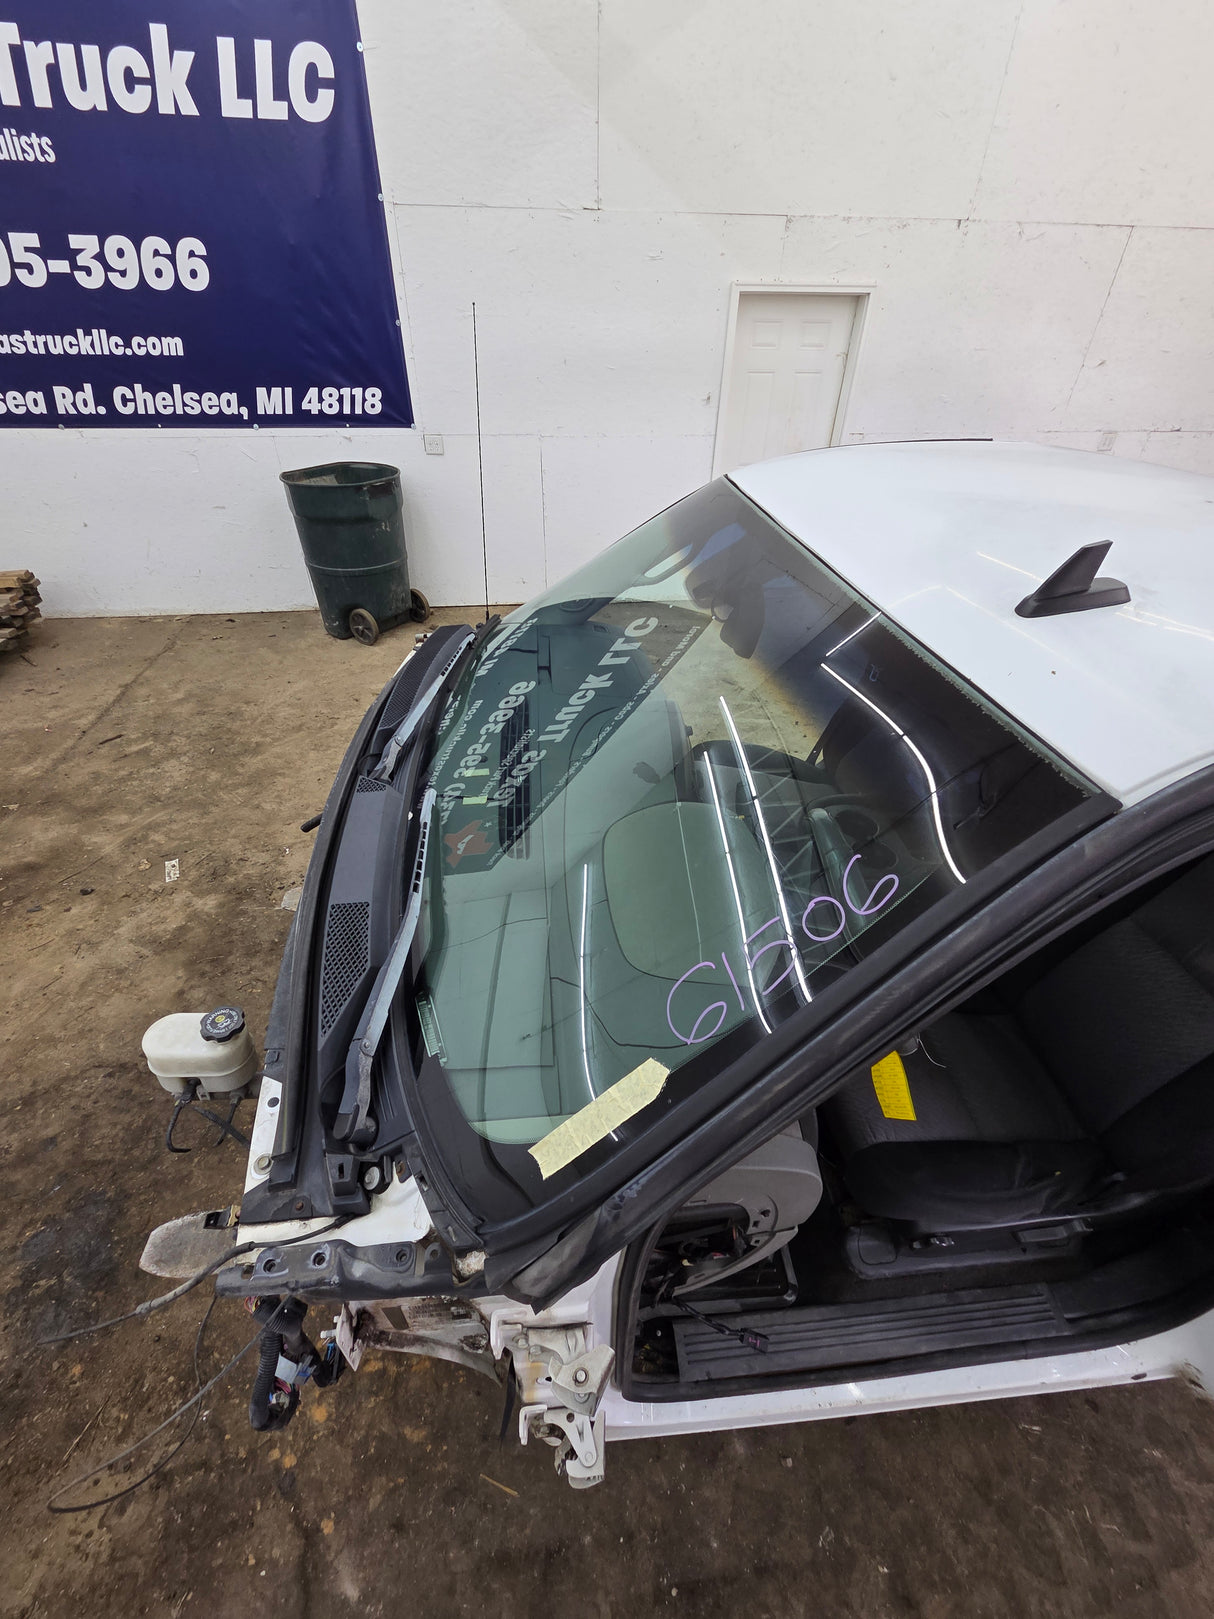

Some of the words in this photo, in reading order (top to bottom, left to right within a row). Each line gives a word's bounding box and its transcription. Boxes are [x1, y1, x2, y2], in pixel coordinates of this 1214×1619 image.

[0, 22, 200, 116] Truck
[216, 35, 335, 123] LLC
[52, 382, 107, 415] Rd.
[112, 383, 249, 420] Chelsea,
[255, 386, 293, 415] MI
[301, 387, 383, 415] 48118
[666, 853, 900, 1045] 61506
